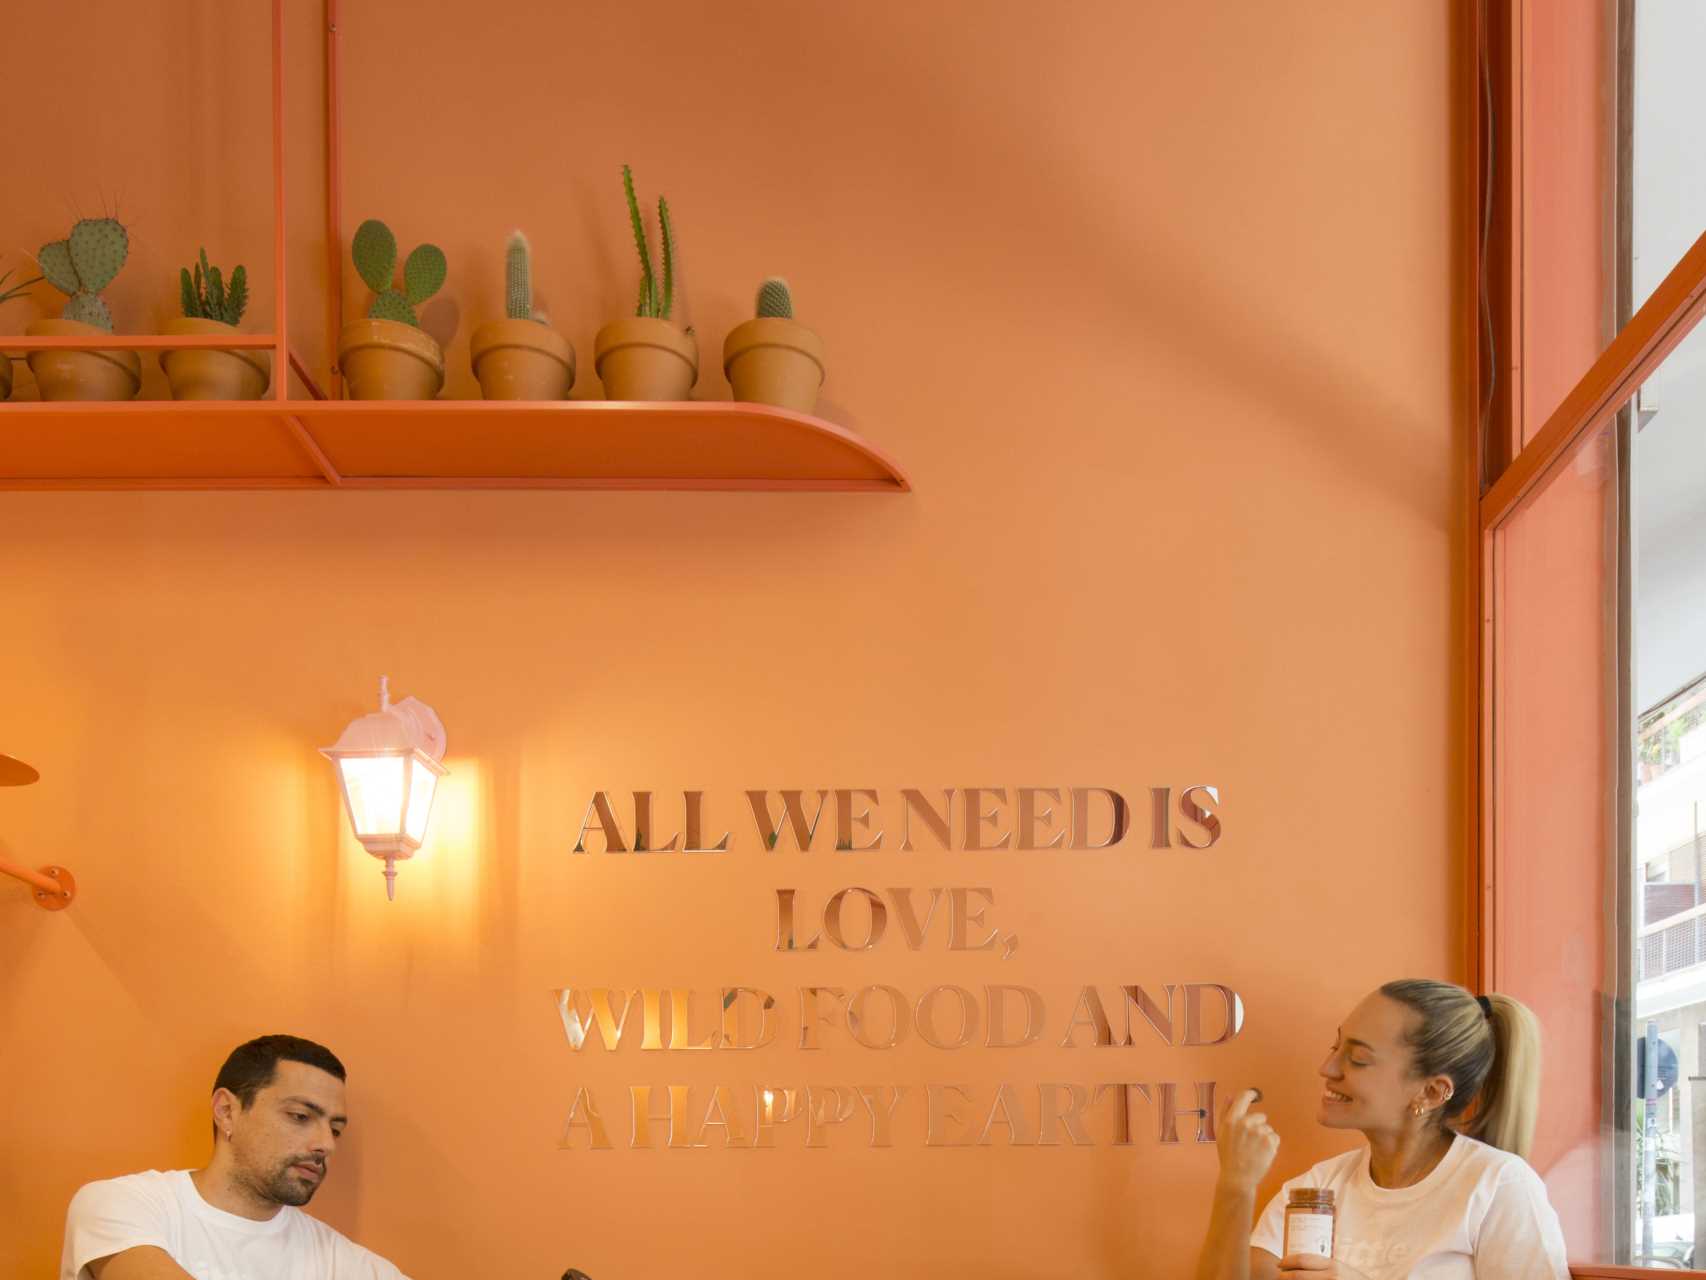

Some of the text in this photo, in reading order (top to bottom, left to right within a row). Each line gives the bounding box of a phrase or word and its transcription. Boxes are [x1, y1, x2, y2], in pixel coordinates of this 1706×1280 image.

[572, 785, 1223, 854] ALL WE NEED IS
[775, 887, 1020, 960] LOVE,
[553, 983, 1246, 1052] WILD FOOD AND
[556, 1081, 1217, 1150] A HAPPY EARTH
